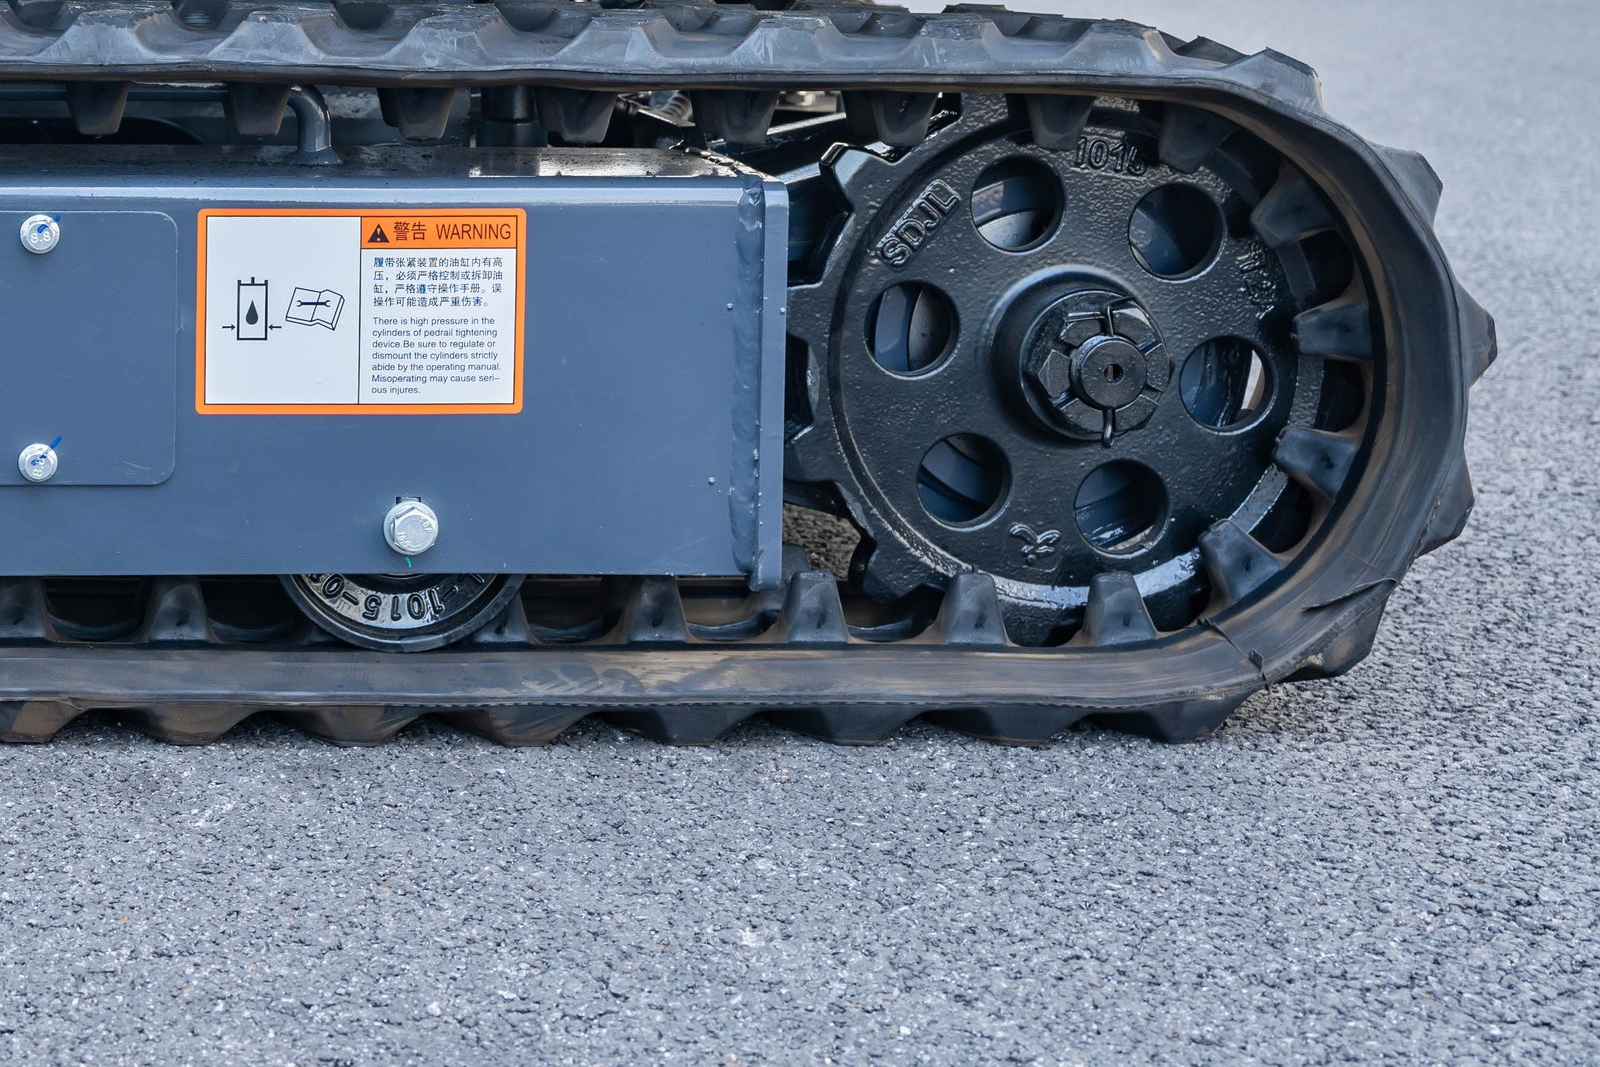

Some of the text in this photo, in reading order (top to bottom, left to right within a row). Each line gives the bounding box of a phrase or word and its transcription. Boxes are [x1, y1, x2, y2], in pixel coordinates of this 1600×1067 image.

[393, 222, 511, 241] 警告 WARNING
[880, 189, 961, 268] SDJL
[30, 231, 51, 243] 8.8
[374, 257, 502, 268] 履带张紧装置的油缸内有高
[374, 270, 502, 281] 压，必须严格控制或拆卸油
[373, 297, 488, 307] 操作可能造成严重伤害。
[410, 317, 429, 326] high
[430, 318, 469, 326] pressure
[372, 328, 411, 338] cylinders
[423, 328, 454, 338] pedrail
[455, 328, 498, 338] tightening
[449, 340, 485, 349] regulate
[429, 351, 468, 361] cylinders
[470, 351, 498, 361] strictly
[397, 362, 409, 372] by
[425, 362, 466, 372] operating
[371, 374, 428, 384] Misoperating
[429, 375, 448, 384] may
[389, 385, 420, 395] injures.
